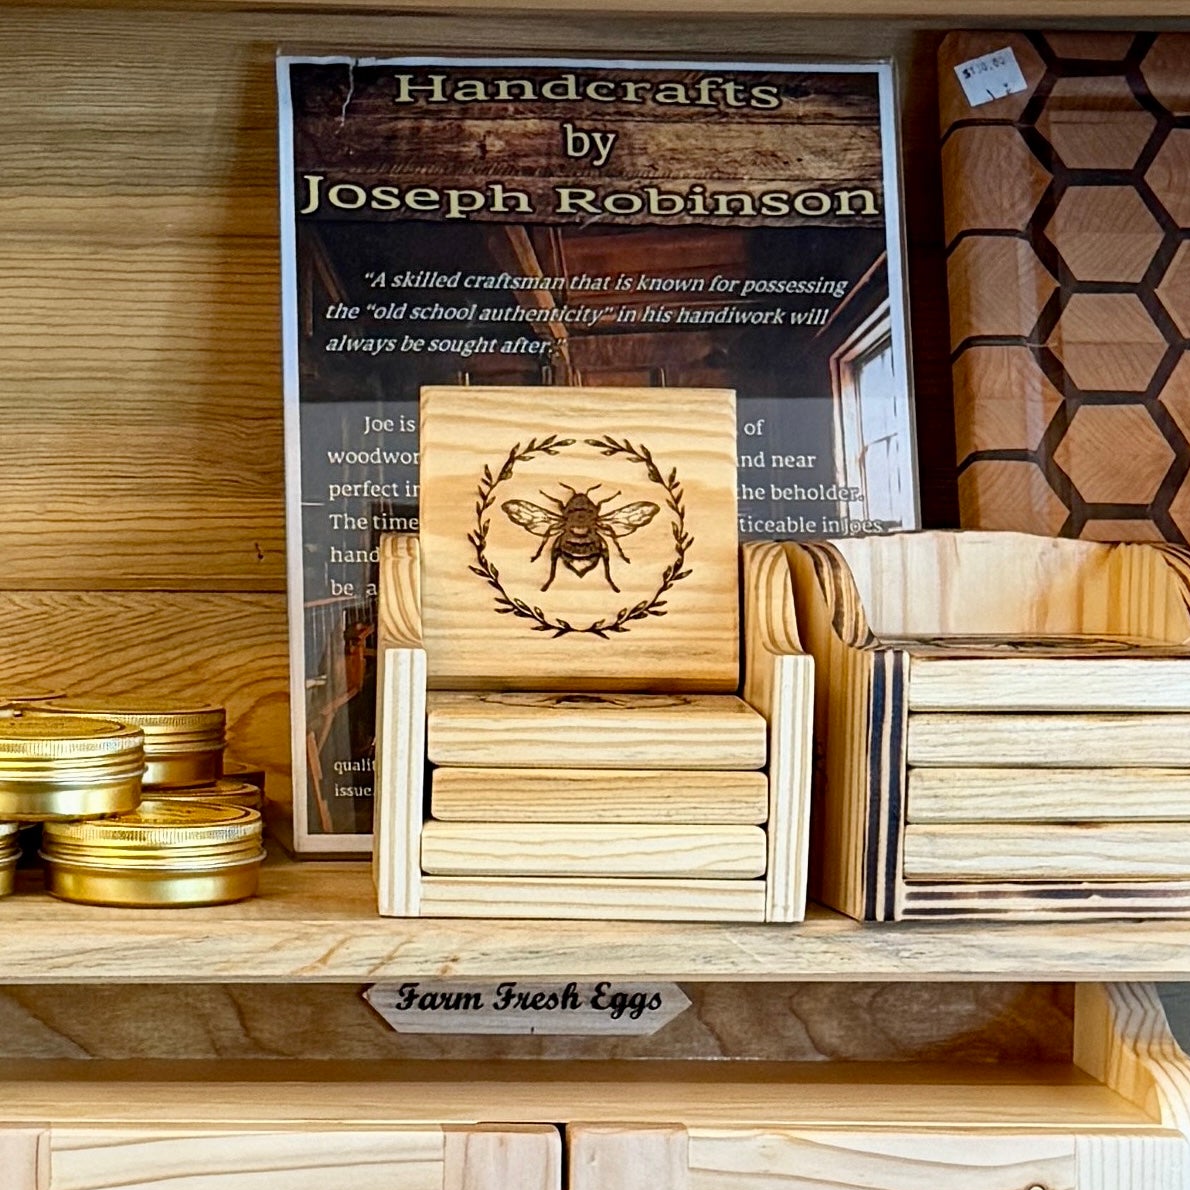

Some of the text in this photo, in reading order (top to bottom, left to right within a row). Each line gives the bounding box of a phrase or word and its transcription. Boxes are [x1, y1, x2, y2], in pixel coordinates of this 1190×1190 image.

[394, 73, 780, 109] Handcrafts
[562, 124, 616, 166] by
[300, 175, 879, 219] Joseph Robinson
[391, 271, 462, 289] skilled
[464, 273, 564, 290] craftsman
[569, 274, 610, 291] that
[615, 274, 632, 291] is
[636, 275, 705, 292] known
[708, 275, 738, 294] for
[740, 277, 848, 298] possessing
[326, 303, 360, 320] the
[409, 303, 478, 321] school
[617, 306, 636, 323] in
[640, 306, 671, 323] his
[676, 307, 787, 325] handiwork
[790, 308, 829, 325] will
[326, 335, 396, 356] always
[400, 335, 425, 352] be
[428, 337, 497, 357] sought
[364, 414, 416, 435] Joe is
[744, 418, 765, 436] of
[737, 451, 817, 468] nd near
[329, 480, 399, 501] perfect
[737, 484, 864, 502] he beholder.
[329, 514, 369, 530] The
[822, 516, 839, 533] in
[331, 579, 354, 596] be
[395, 981, 662, 1020] Farm Fresh Eggs
